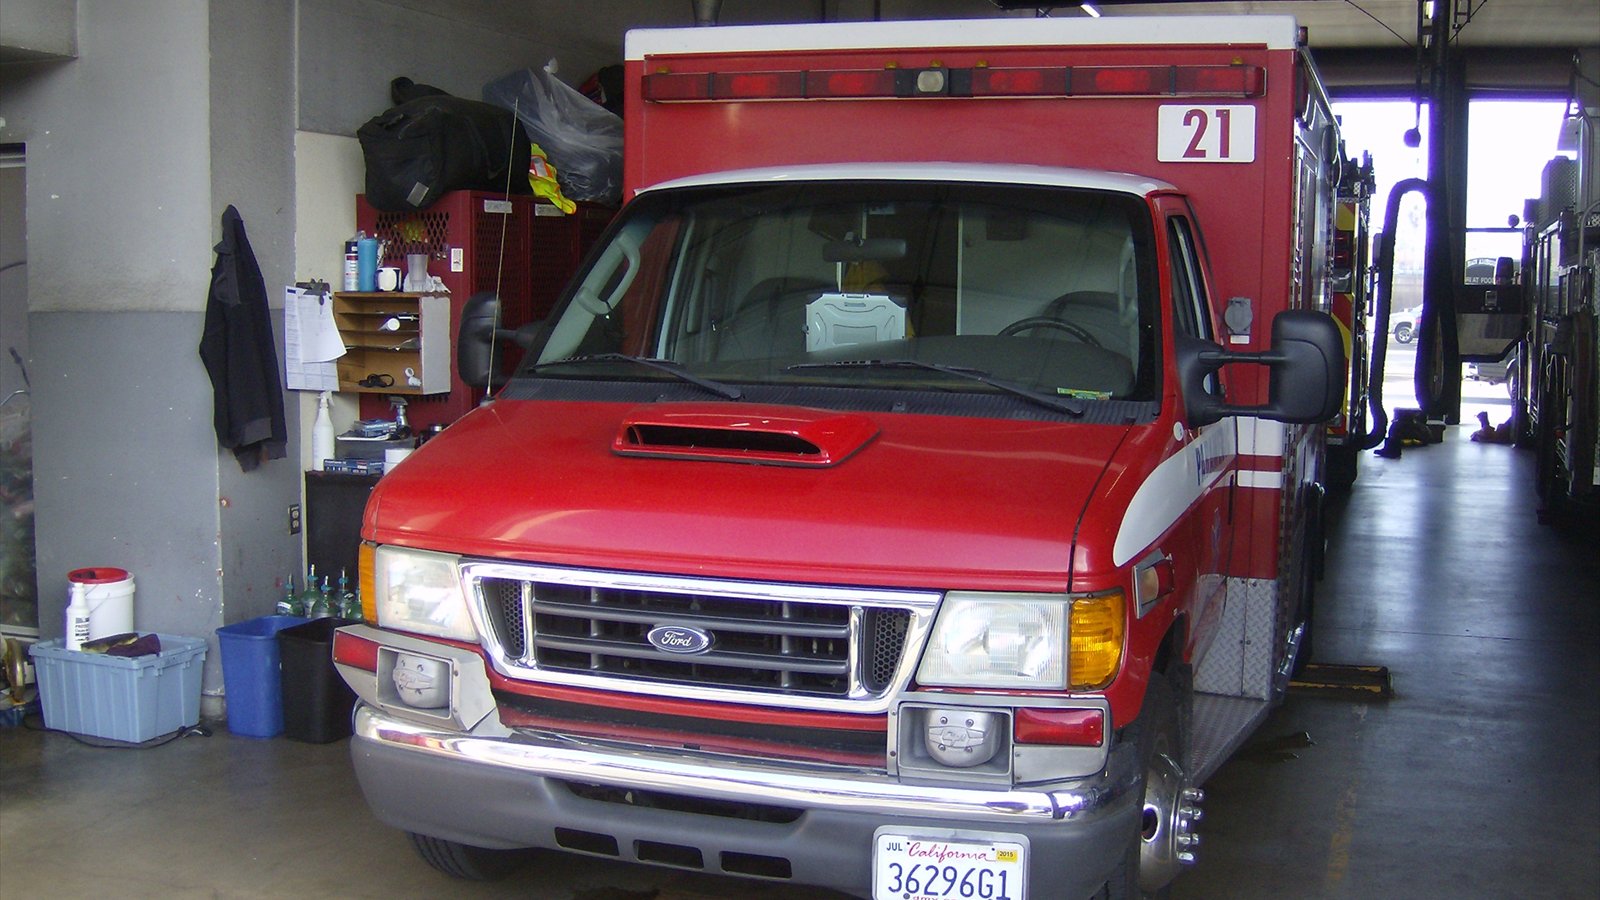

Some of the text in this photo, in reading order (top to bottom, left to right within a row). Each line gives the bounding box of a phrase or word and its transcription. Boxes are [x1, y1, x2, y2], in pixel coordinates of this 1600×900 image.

[1182, 109, 1231, 158] 21
[661, 630, 693, 647] Ford
[886, 842, 903, 852] JUL
[908, 842, 995, 863] California
[999, 850, 1014, 858] 2015
[887, 862, 1011, 900] 36296G1
